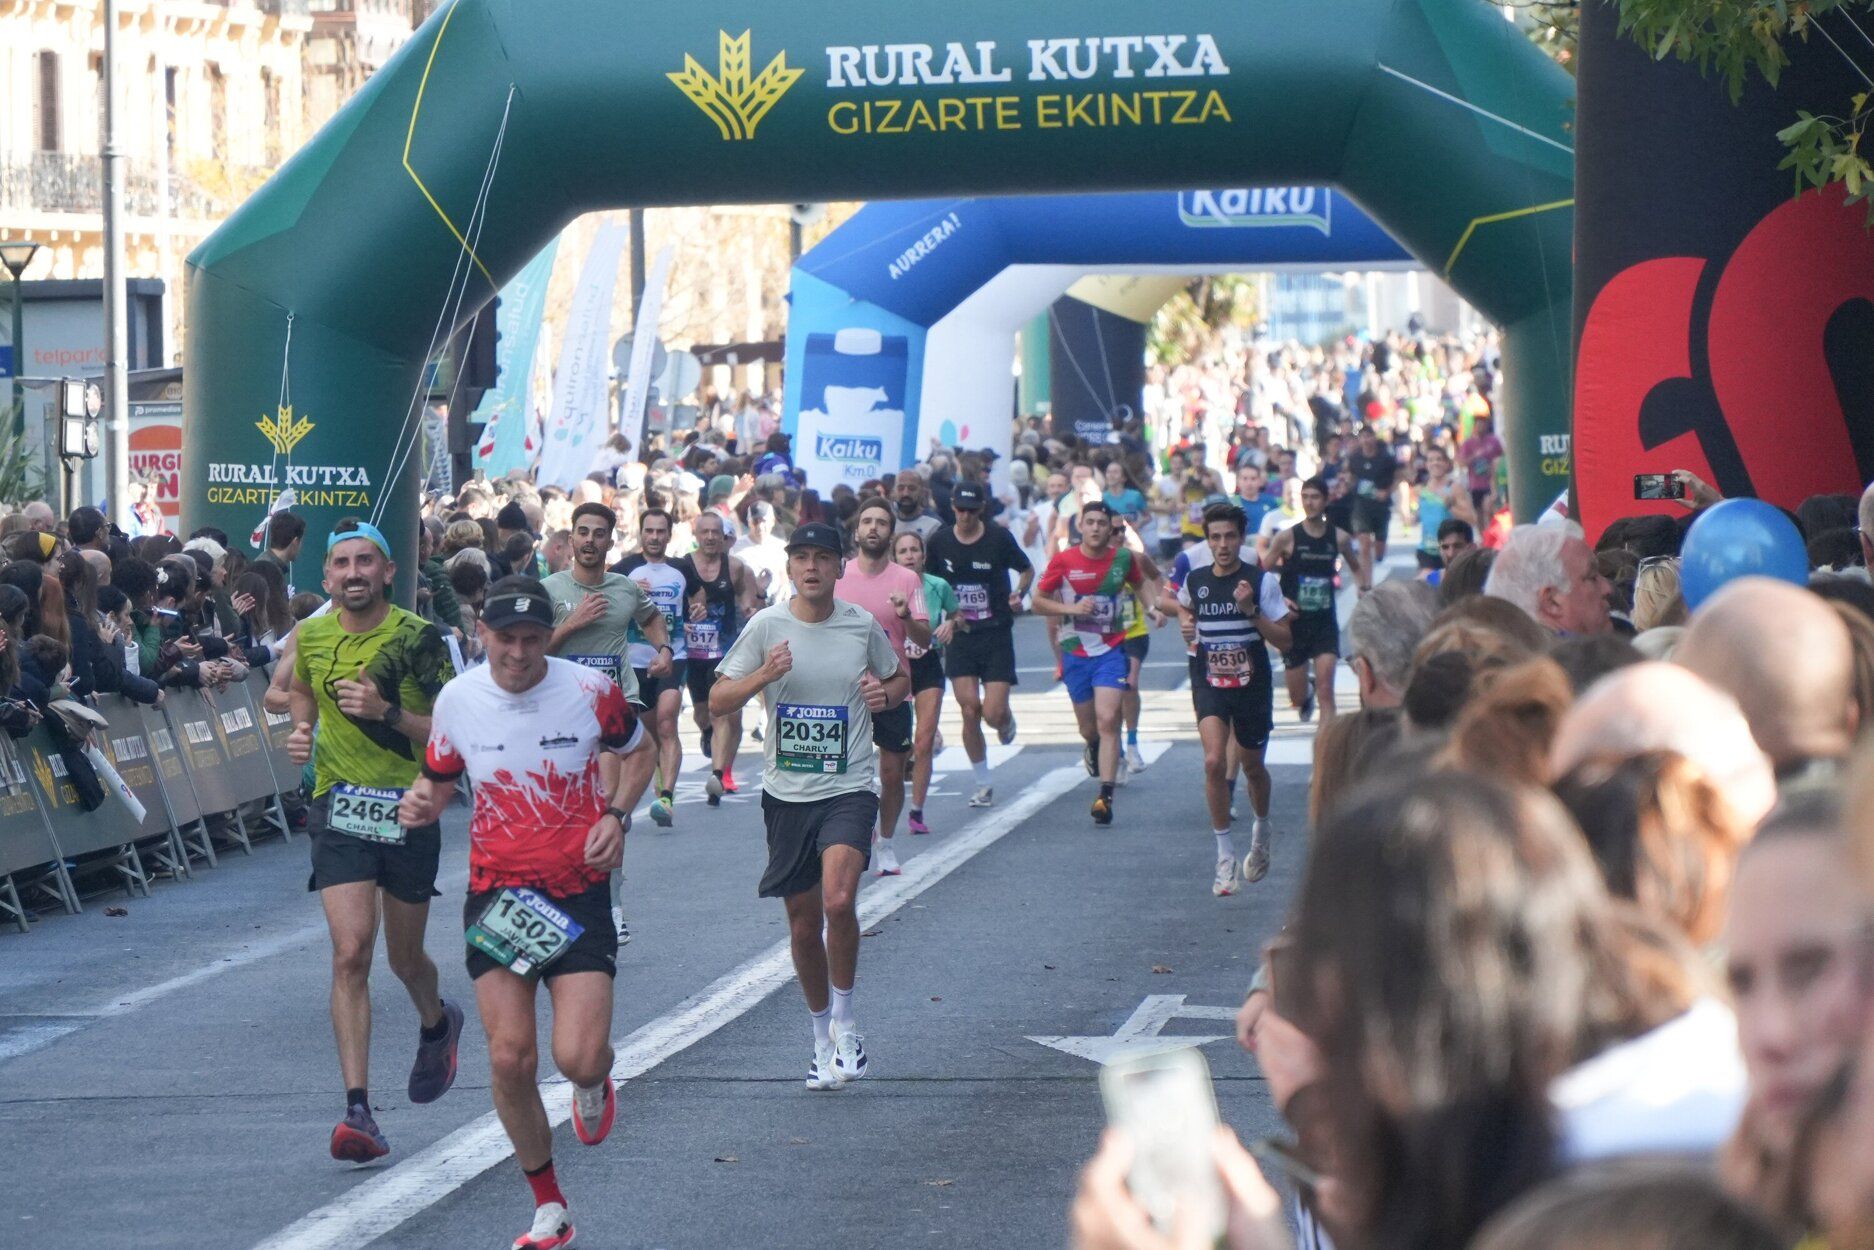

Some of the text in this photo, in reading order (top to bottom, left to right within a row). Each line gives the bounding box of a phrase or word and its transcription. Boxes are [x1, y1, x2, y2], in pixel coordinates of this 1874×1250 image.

[826, 34, 1230, 88] RURAL KUTXA
[827, 90, 1231, 134] GIZARTE EKINTZA
[888, 212, 962, 280] AURRERA!
[820, 438, 878, 460] Kaiku
[129, 453, 181, 471] URG
[208, 463, 371, 486] RURAL KUTXA
[207, 487, 281, 505] GIZARTE
[691, 632, 715, 643] 617
[1210, 651, 1247, 667] 4630
[782, 721, 841, 743] 2034
[793, 744, 828, 753] CHARLY
[334, 797, 400, 825] 2464
[499, 899, 562, 954] 1502
